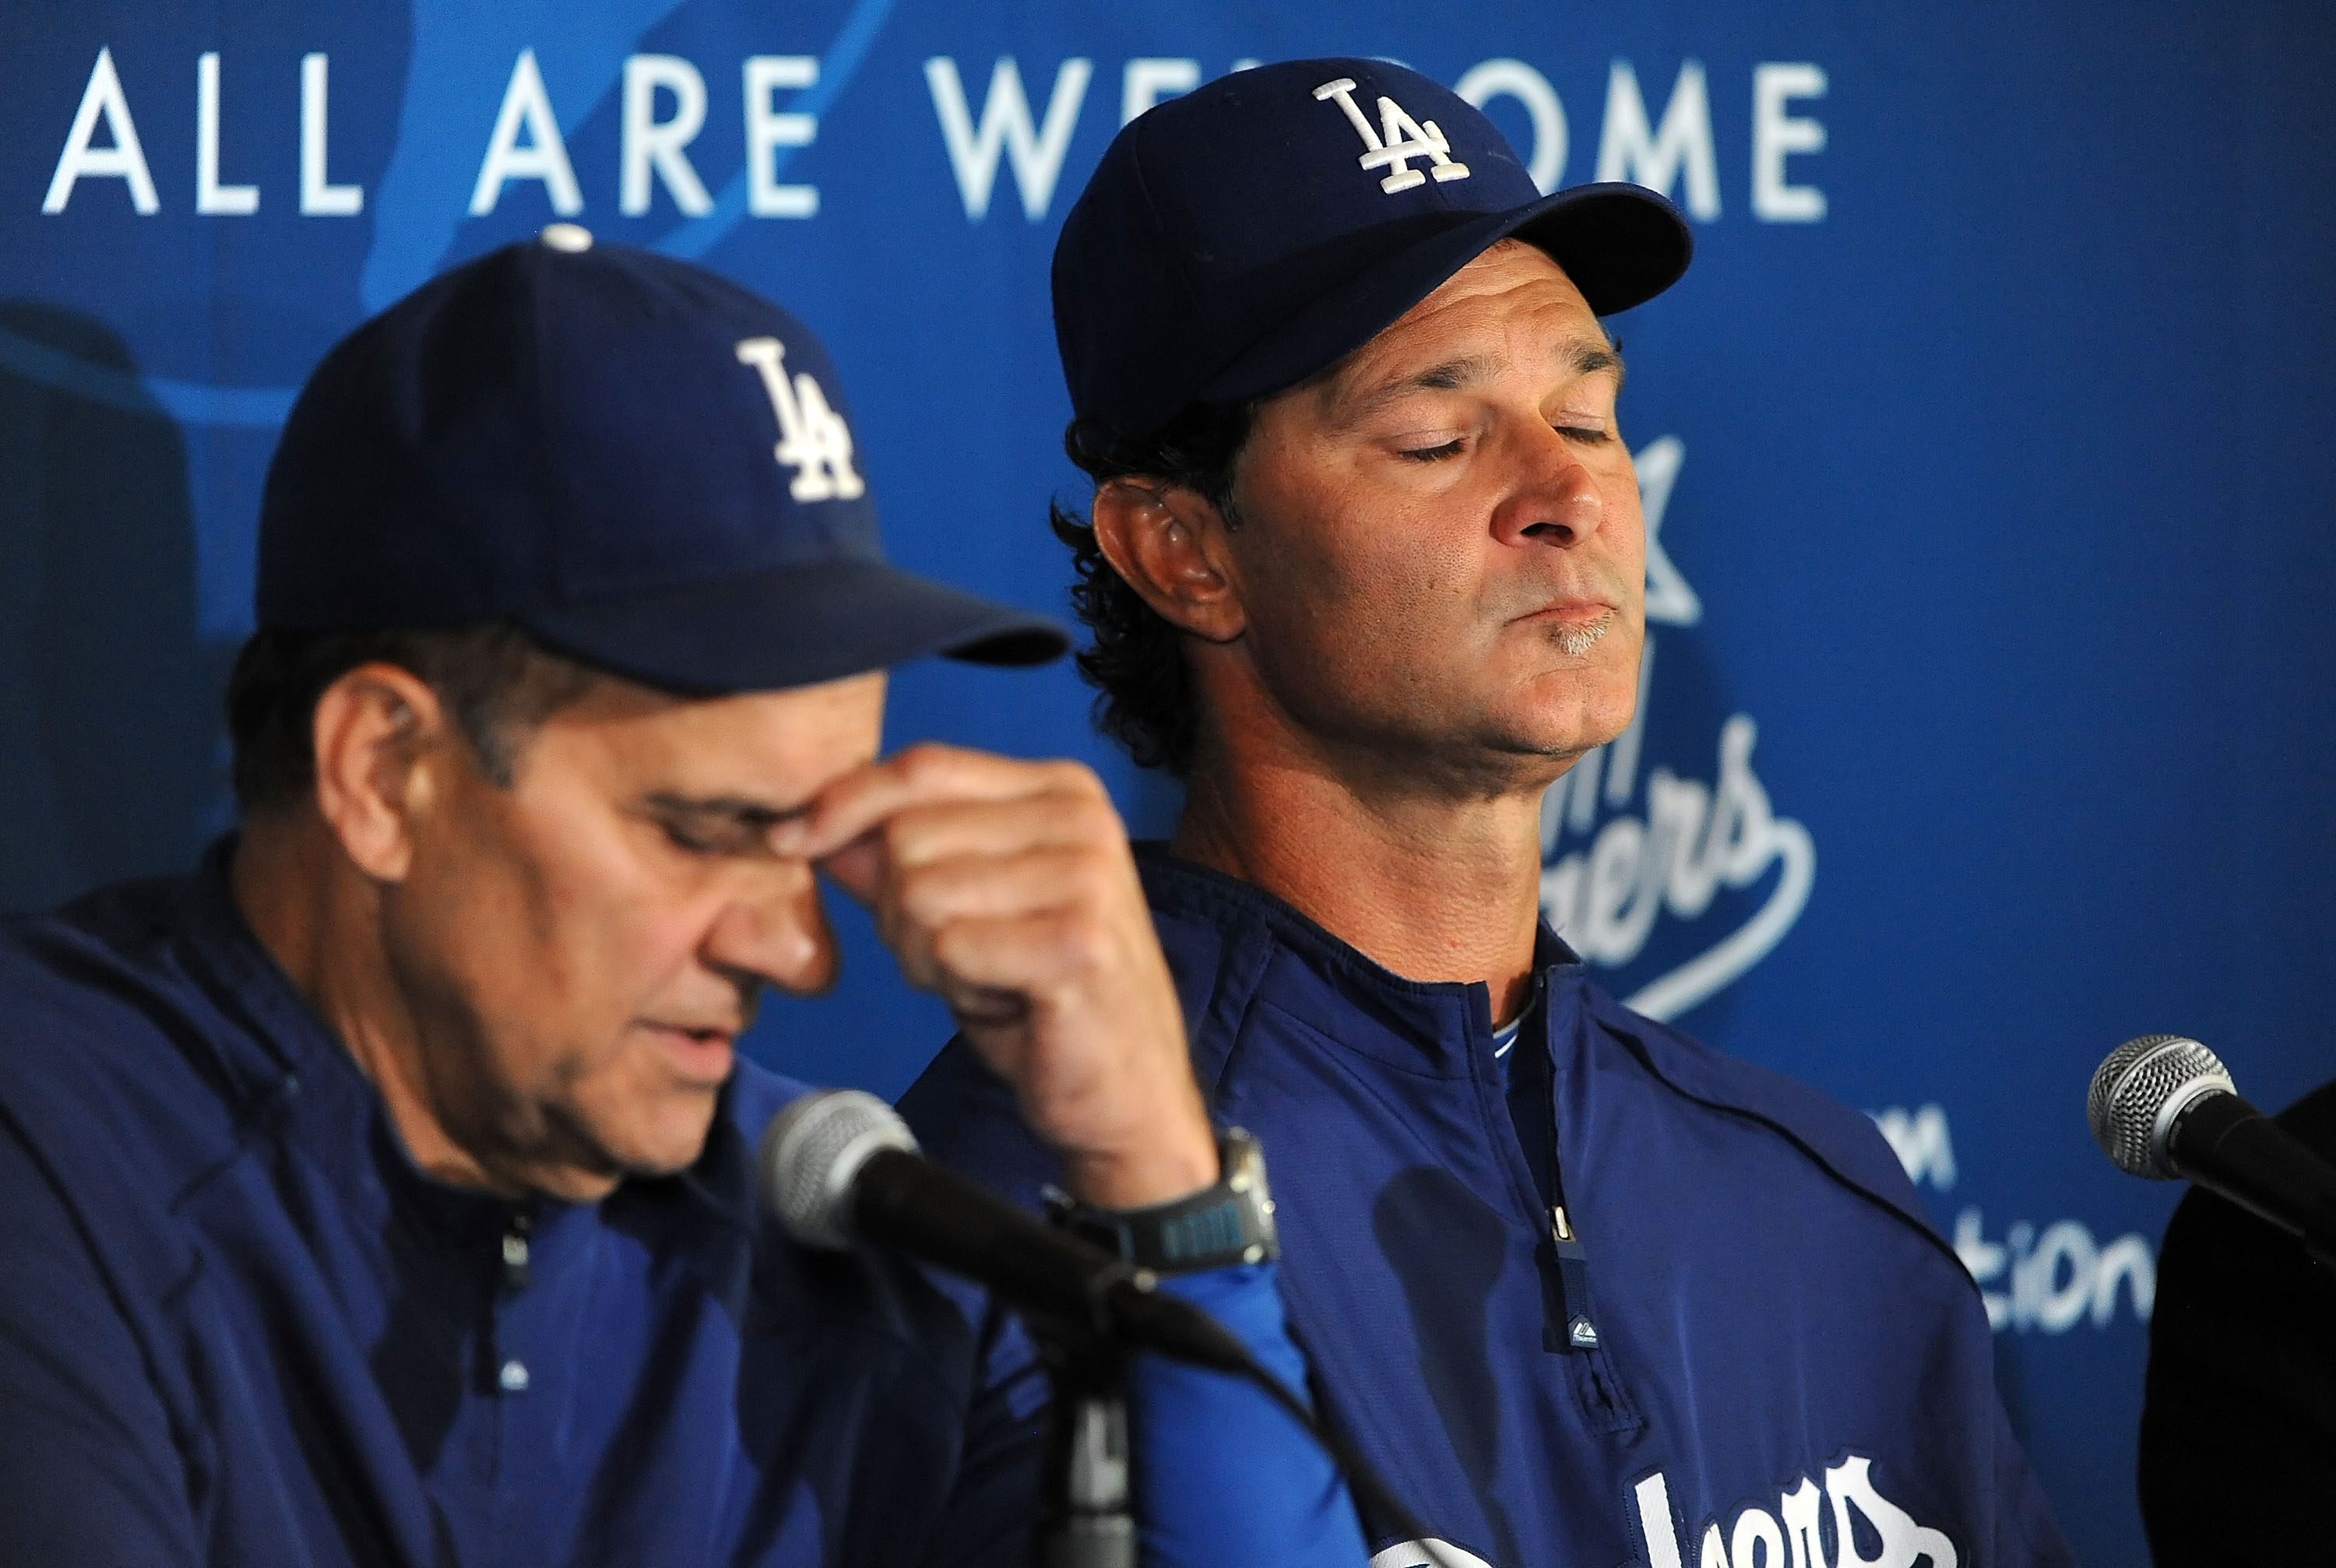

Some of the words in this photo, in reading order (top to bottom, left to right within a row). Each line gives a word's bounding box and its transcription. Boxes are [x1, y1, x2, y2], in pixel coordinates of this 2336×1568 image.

[40, 47, 364, 216] ALL
[468, 47, 820, 219] ARE
[923, 56, 1830, 224] WOME
[1311, 78, 1470, 195] LA
[735, 336, 866, 502] LA
